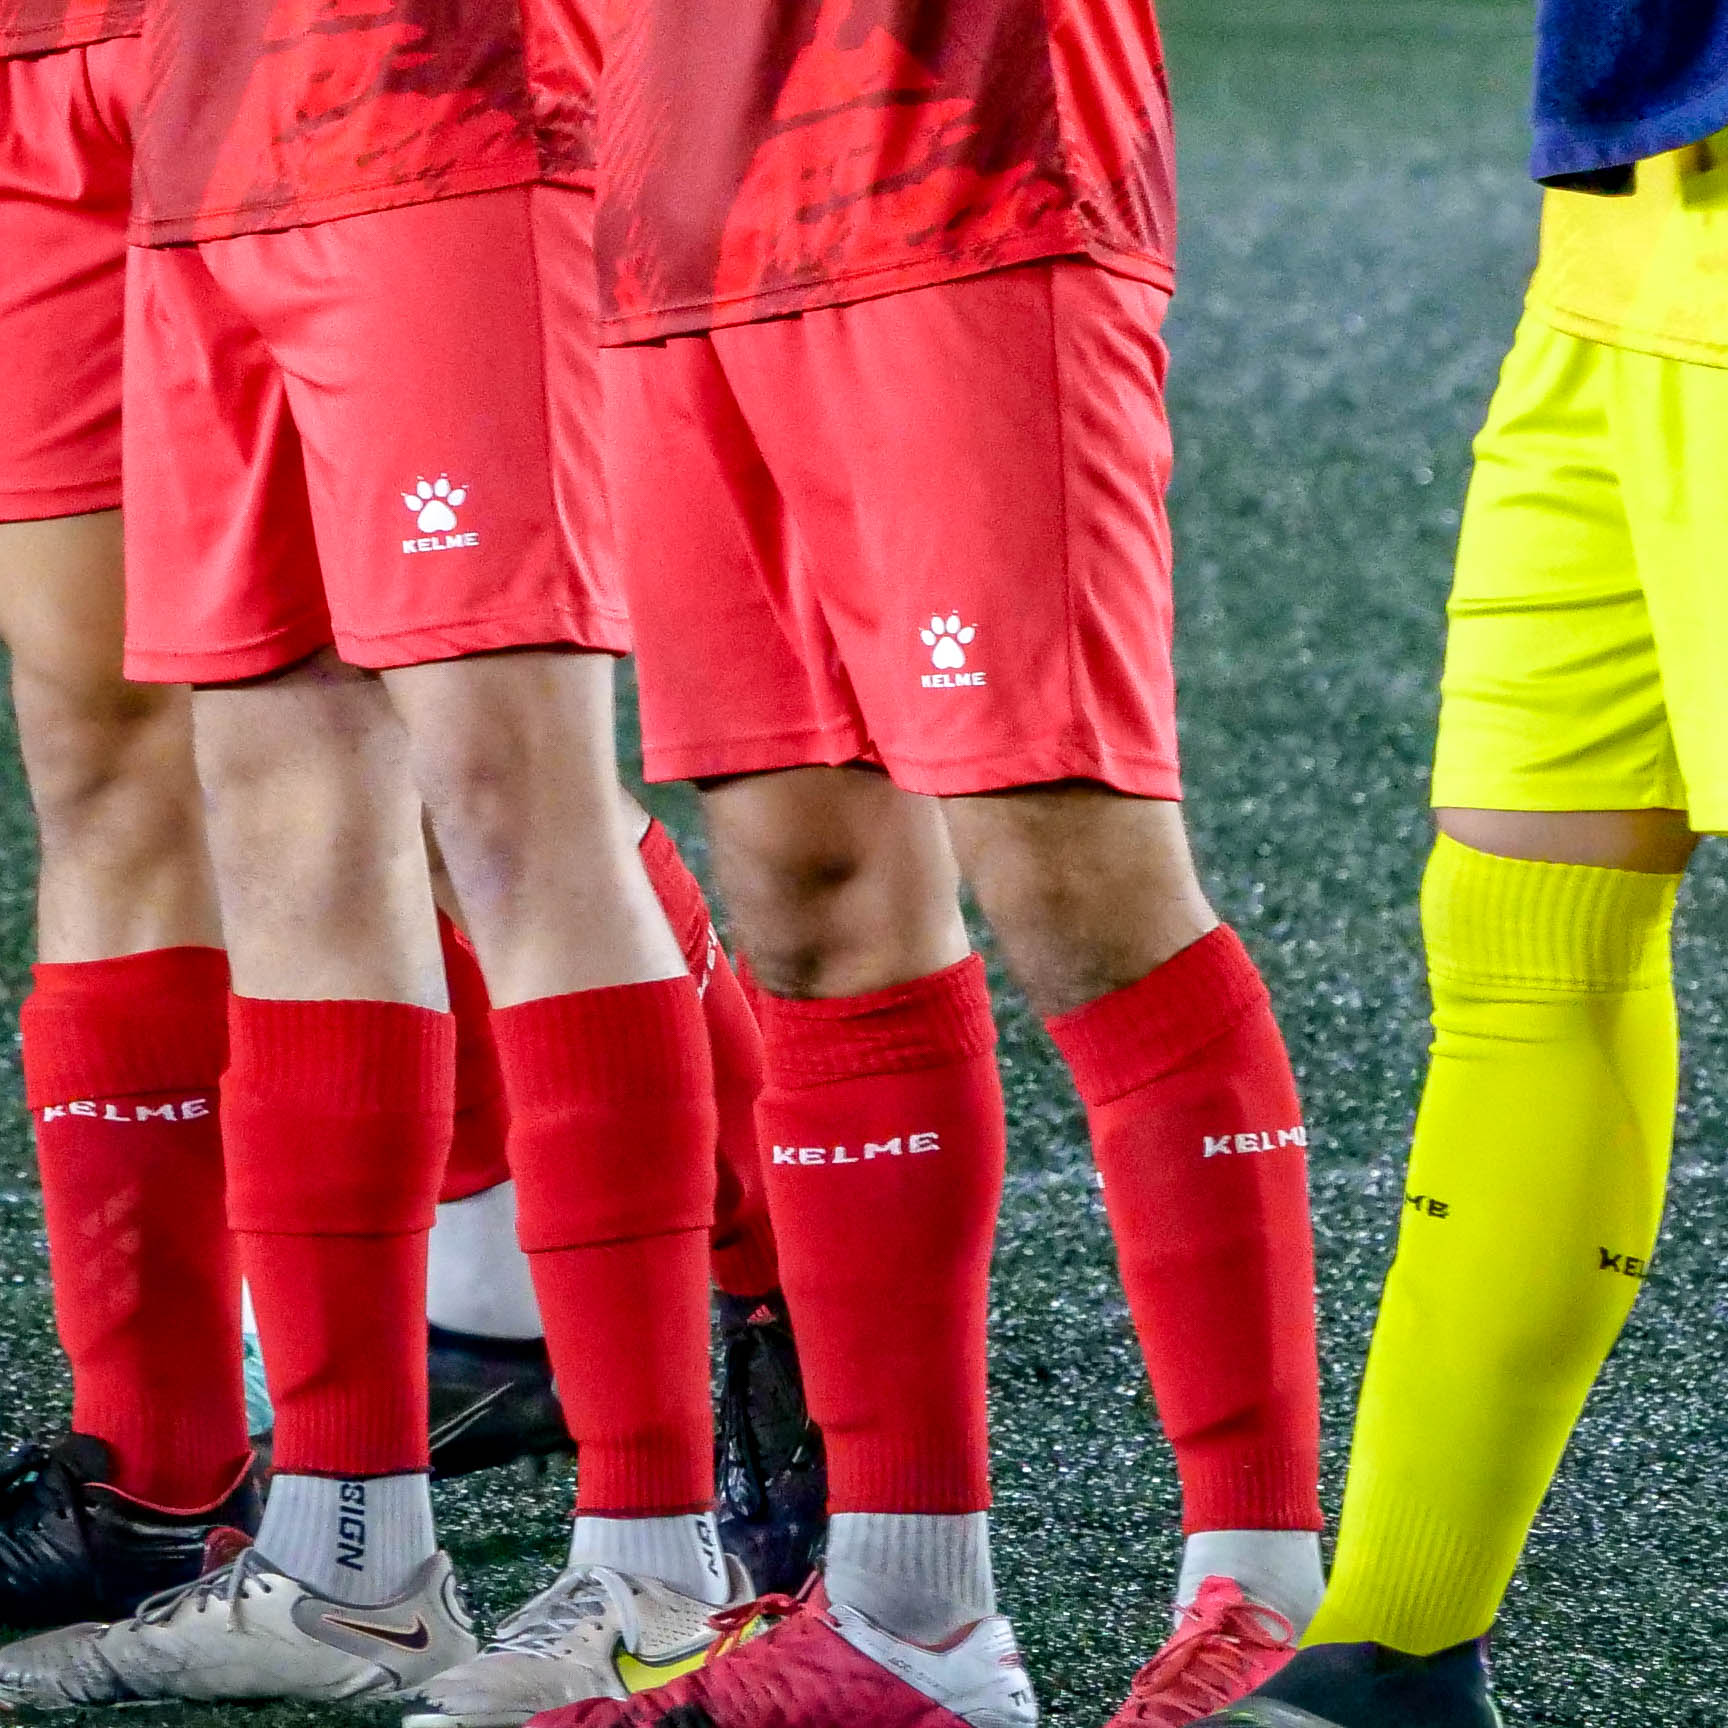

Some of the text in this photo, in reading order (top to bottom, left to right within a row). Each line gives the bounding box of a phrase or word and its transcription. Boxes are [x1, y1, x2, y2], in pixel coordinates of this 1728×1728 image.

[401, 531, 480, 555] KELME
[920, 671, 988, 689] KELME
[43, 1097, 211, 1123] KELME
[772, 1131, 942, 1166] KELME
